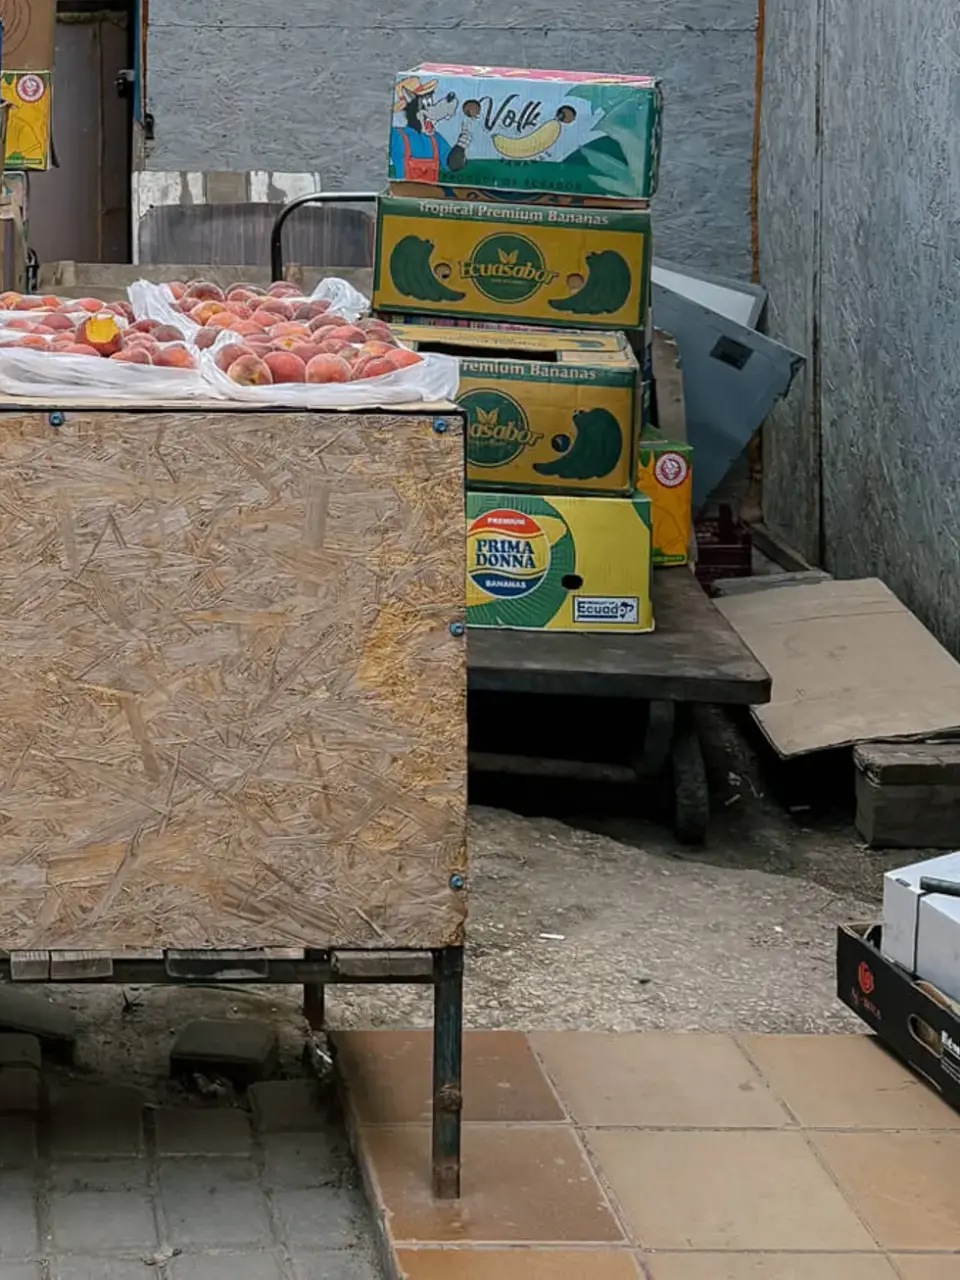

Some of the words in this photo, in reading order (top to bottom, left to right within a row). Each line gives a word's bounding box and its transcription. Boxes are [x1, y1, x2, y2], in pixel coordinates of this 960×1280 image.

[479, 94, 542, 133] Volk
[418, 201, 473, 217] Tropical
[477, 205, 544, 221] Premium
[548, 210, 609, 225] Bananas
[531, 363, 598, 379] Bananas
[487, 517, 526, 525] PREMIUM
[476, 539, 535, 554] PRIMA
[476, 553, 537, 568] DONNA
[485, 580, 527, 589] BANANAS
